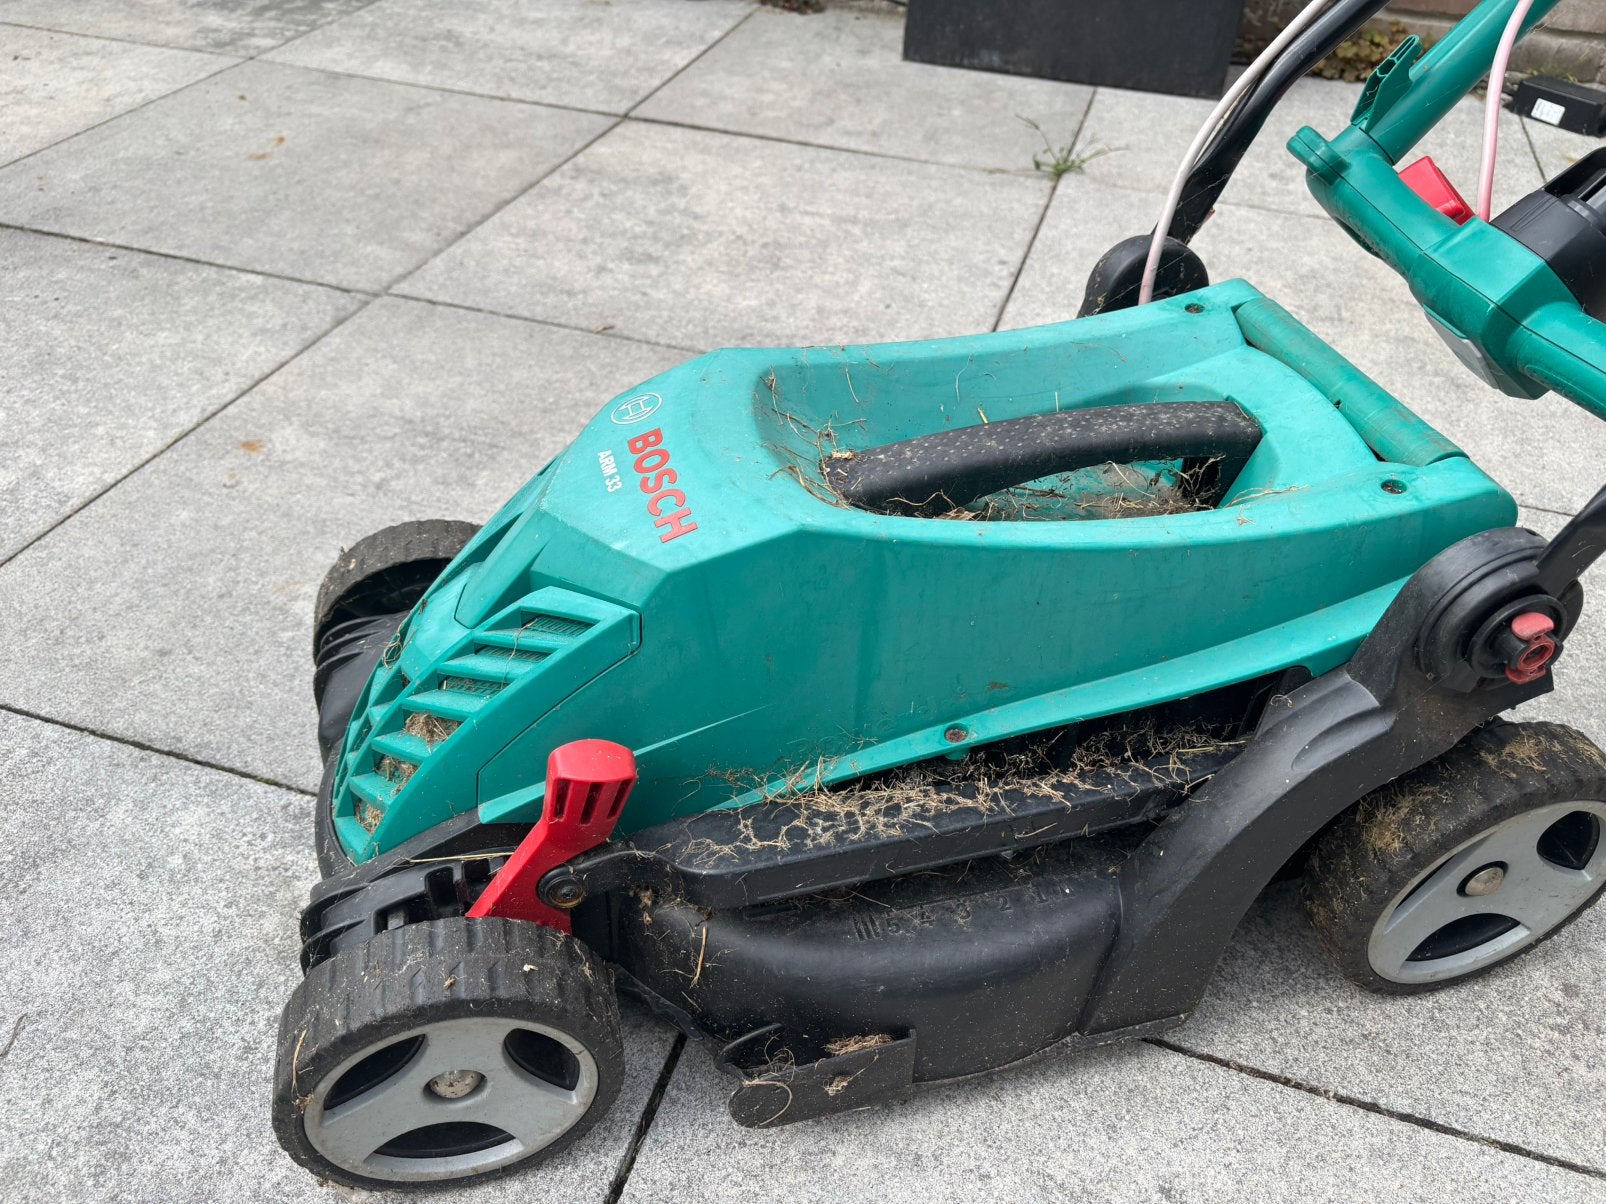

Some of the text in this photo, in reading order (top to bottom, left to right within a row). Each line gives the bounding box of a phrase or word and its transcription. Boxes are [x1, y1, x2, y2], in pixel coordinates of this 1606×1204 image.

[598, 450, 622, 493] ARM 33
[627, 427, 698, 543] BOSCH
